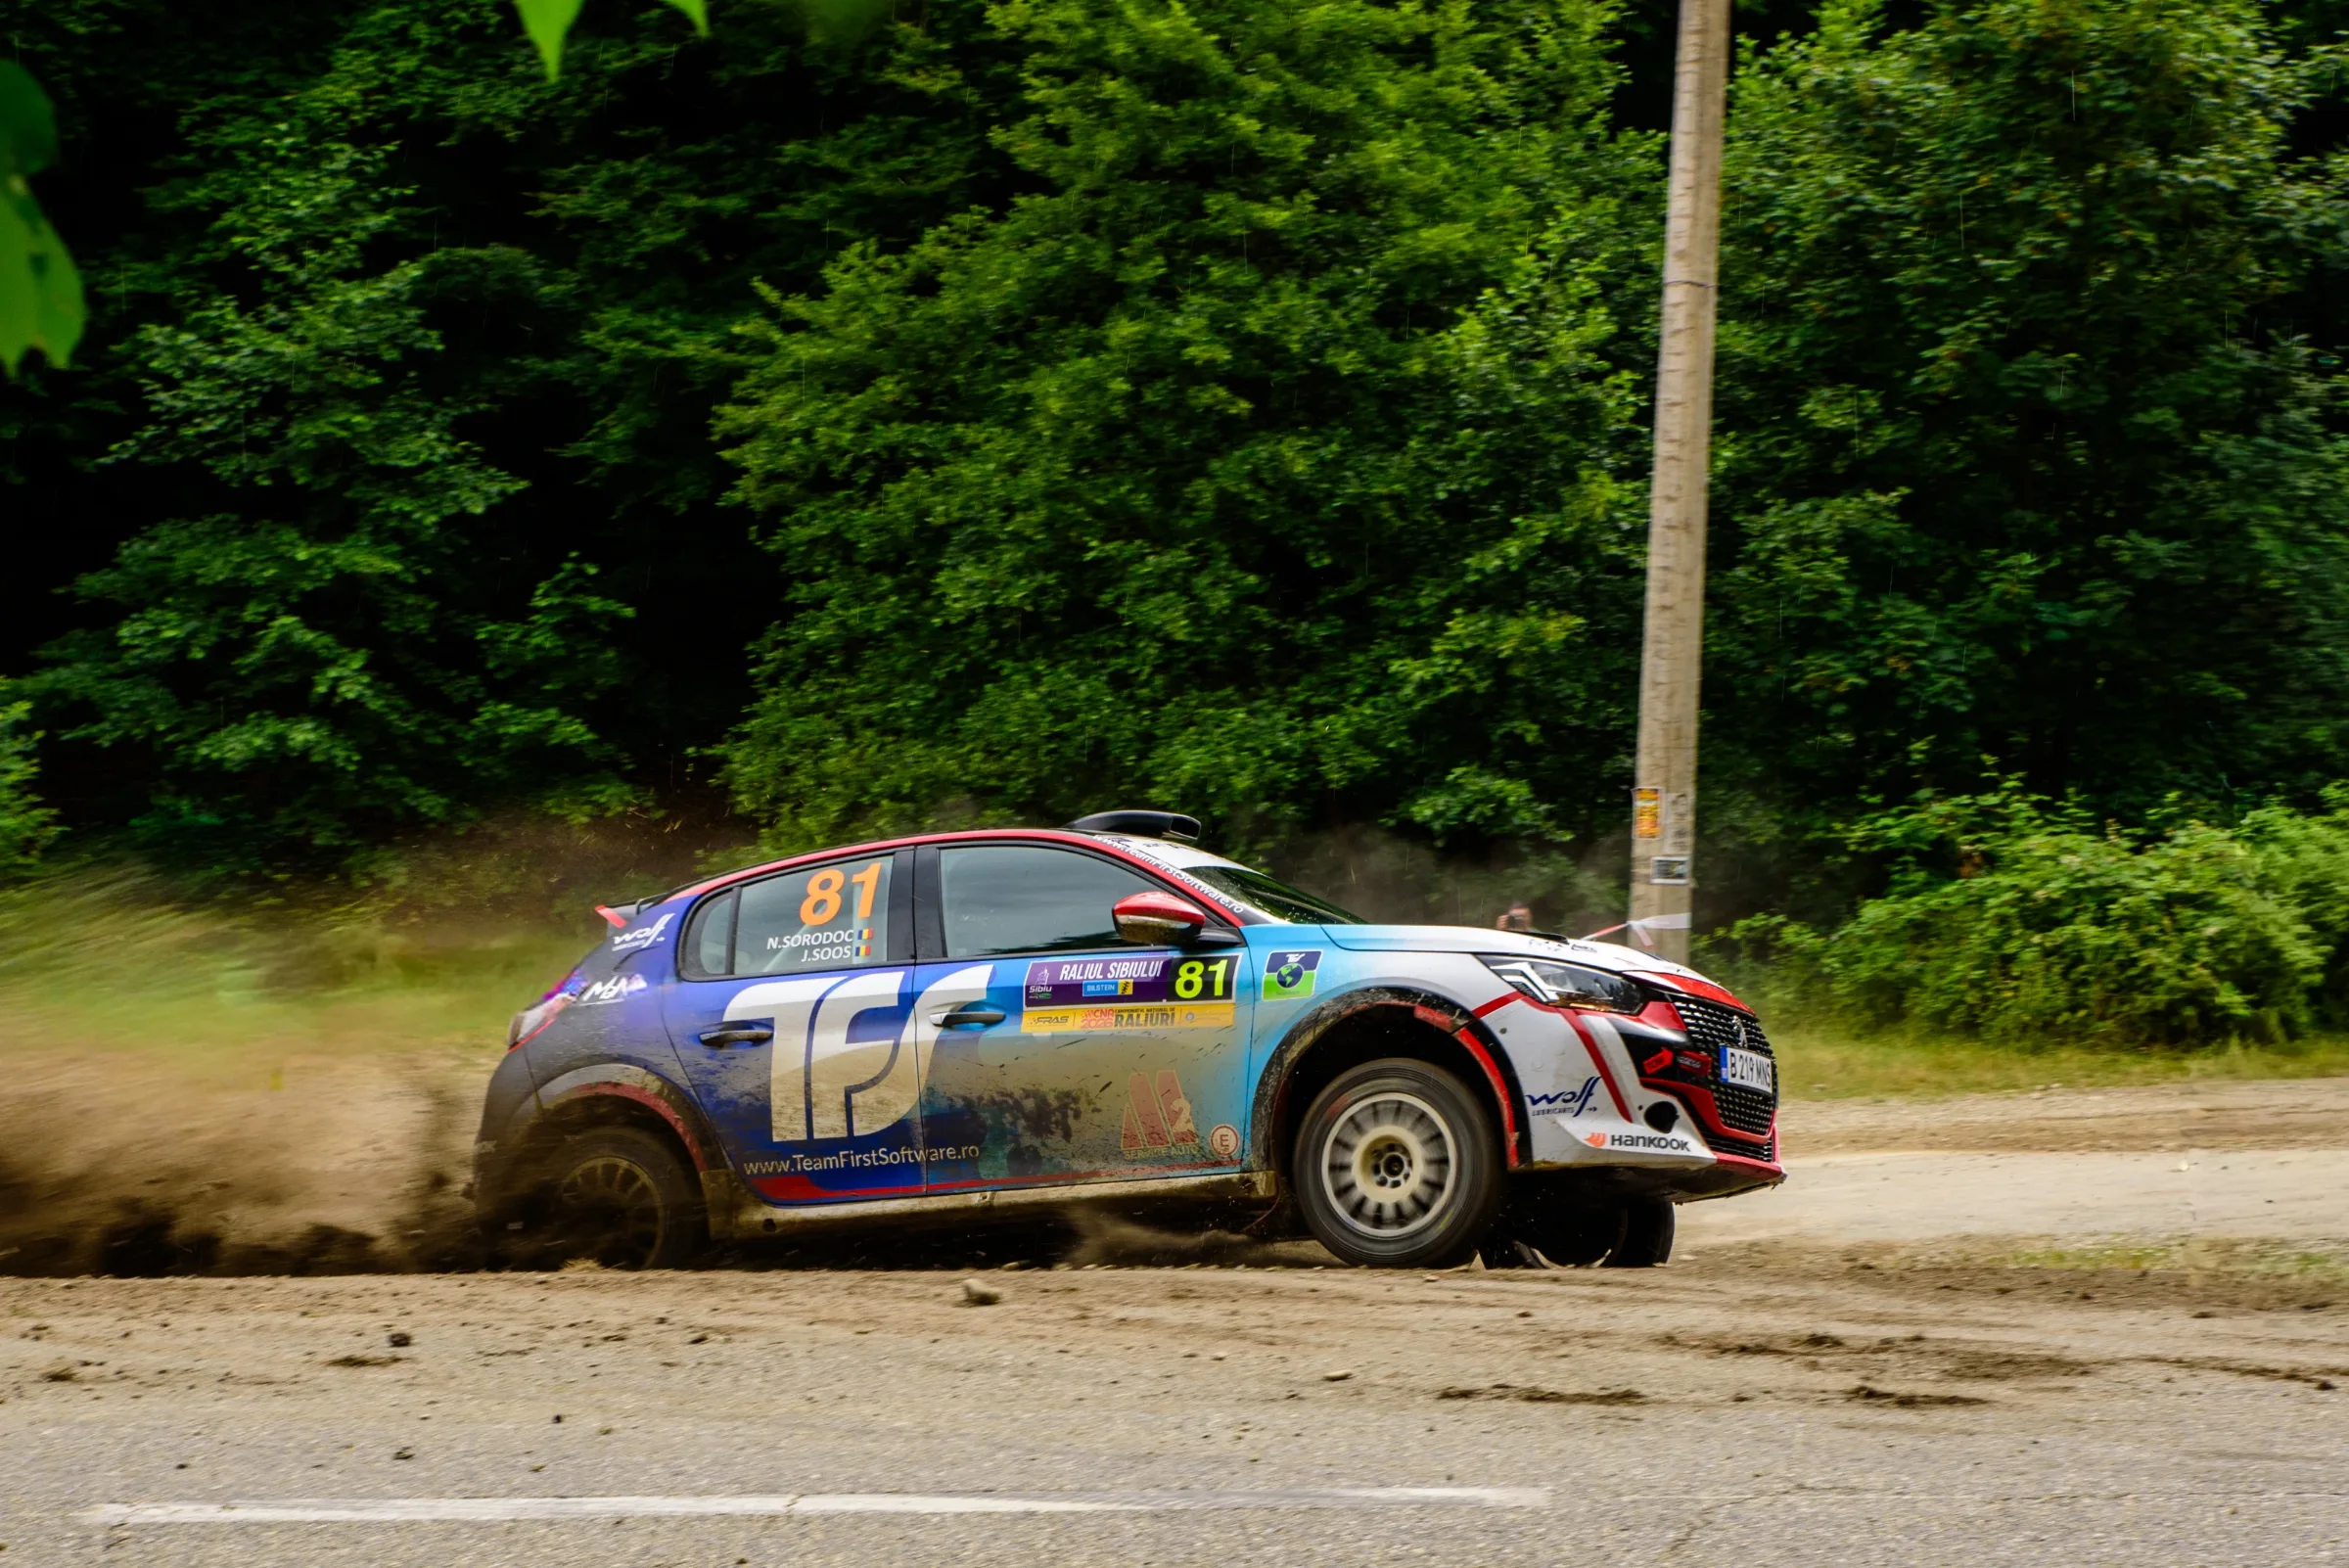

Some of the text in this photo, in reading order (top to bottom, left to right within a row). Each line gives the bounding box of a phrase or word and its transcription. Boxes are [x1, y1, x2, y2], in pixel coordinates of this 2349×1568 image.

[1092, 835, 1244, 914] www.TeamFirstSoftware.ro
[800, 862, 881, 926] 81
[766, 930, 854, 949] N.SORODOC
[801, 945, 852, 962] J.SOOS
[1059, 960, 1163, 981] RALIUL SIBIULUI
[1175, 959, 1228, 998] 81
[1115, 1013, 1174, 1028] RALIURI
[1729, 1052, 1737, 1079] B
[1738, 1054, 1755, 1083] 219
[1756, 1058, 1771, 1088] MNS
[744, 1145, 979, 1175] www.TeamFirstSoftware.ro
